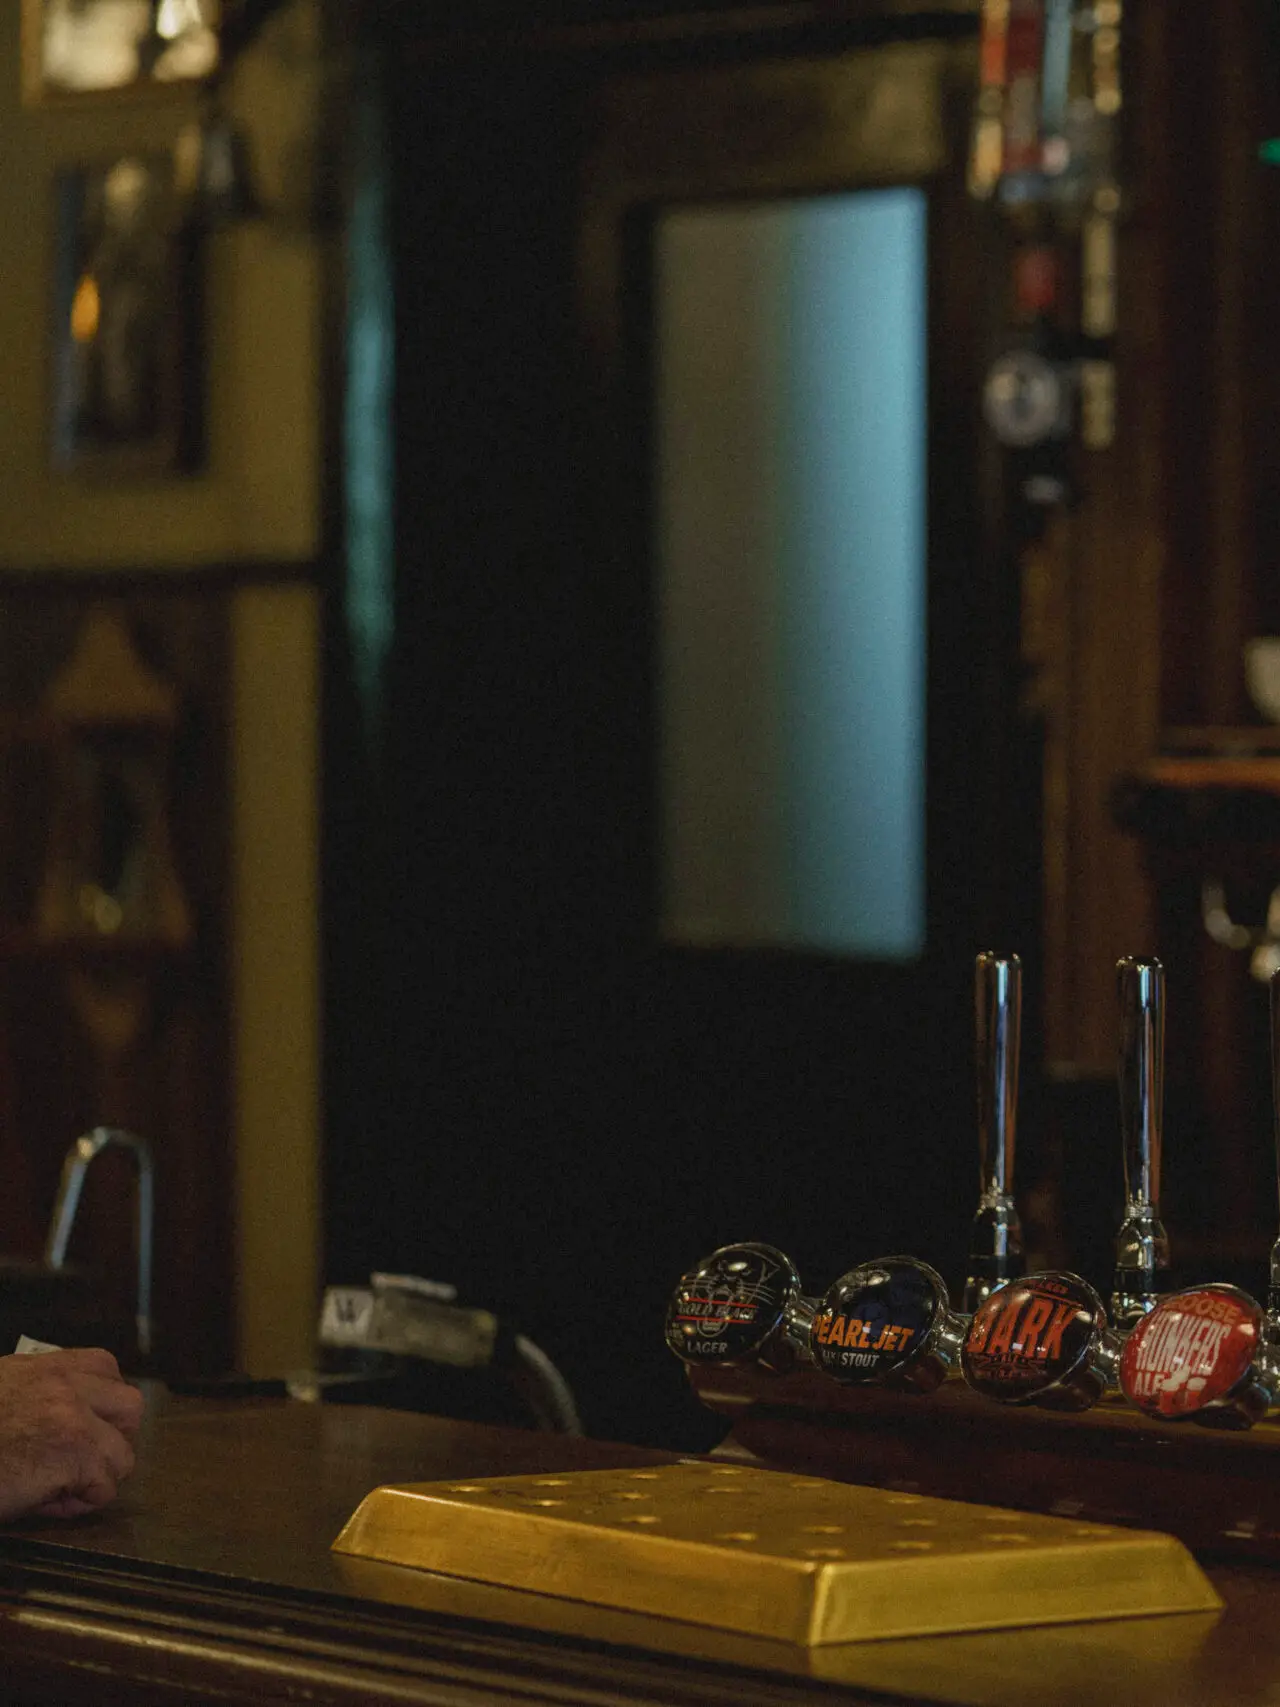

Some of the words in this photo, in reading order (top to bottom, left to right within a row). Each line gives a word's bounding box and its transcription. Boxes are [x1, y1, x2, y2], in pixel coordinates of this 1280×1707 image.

[872, 1324, 915, 1352] JET
[687, 1341, 728, 1353] LAGER
[841, 1352, 880, 1368] STOUT
